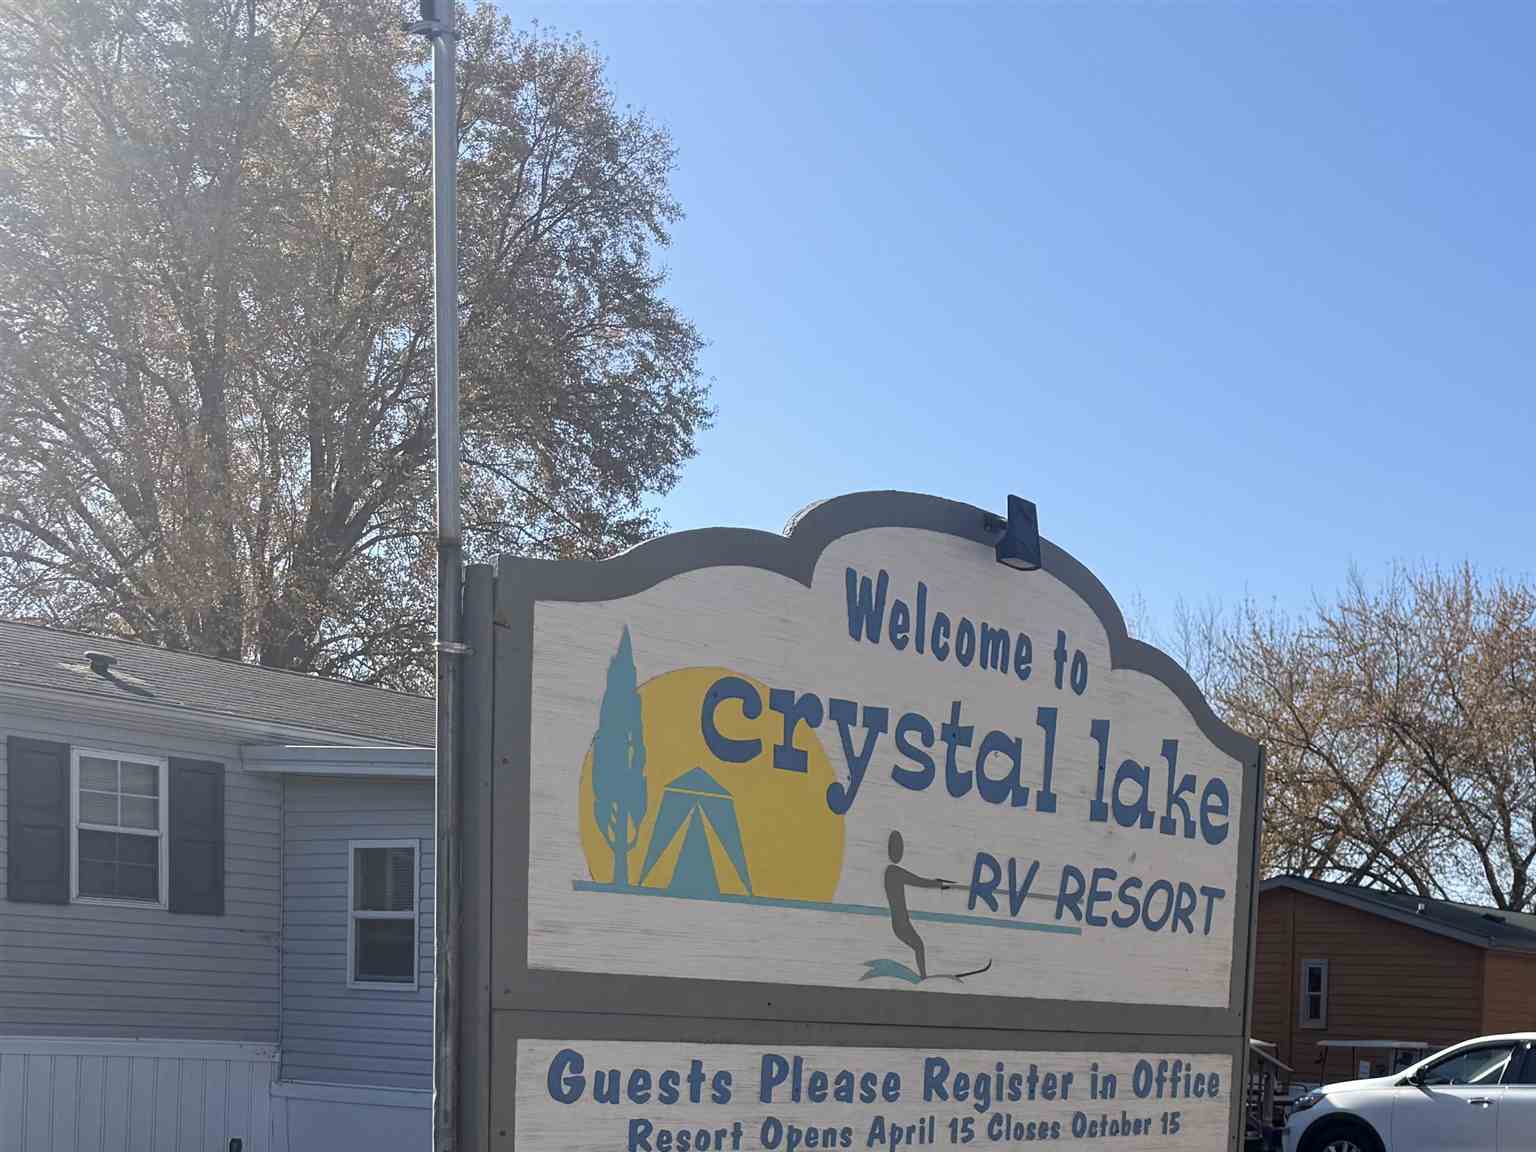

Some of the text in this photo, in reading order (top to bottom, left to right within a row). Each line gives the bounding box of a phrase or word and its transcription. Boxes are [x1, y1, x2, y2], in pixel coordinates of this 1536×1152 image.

[846, 567, 1088, 696] Welcome to
[701, 676, 1230, 845] crystal lake
[968, 851, 1225, 936] RV RESORT
[547, 1048, 1220, 1113] Guests Please Register in Office
[627, 1117, 744, 1152] Resort
[866, 1115, 935, 1152] April
[949, 1115, 975, 1144] 15
[987, 1112, 1061, 1142] Closes
[1071, 1110, 1152, 1139] October
[1160, 1111, 1182, 1135] 15
